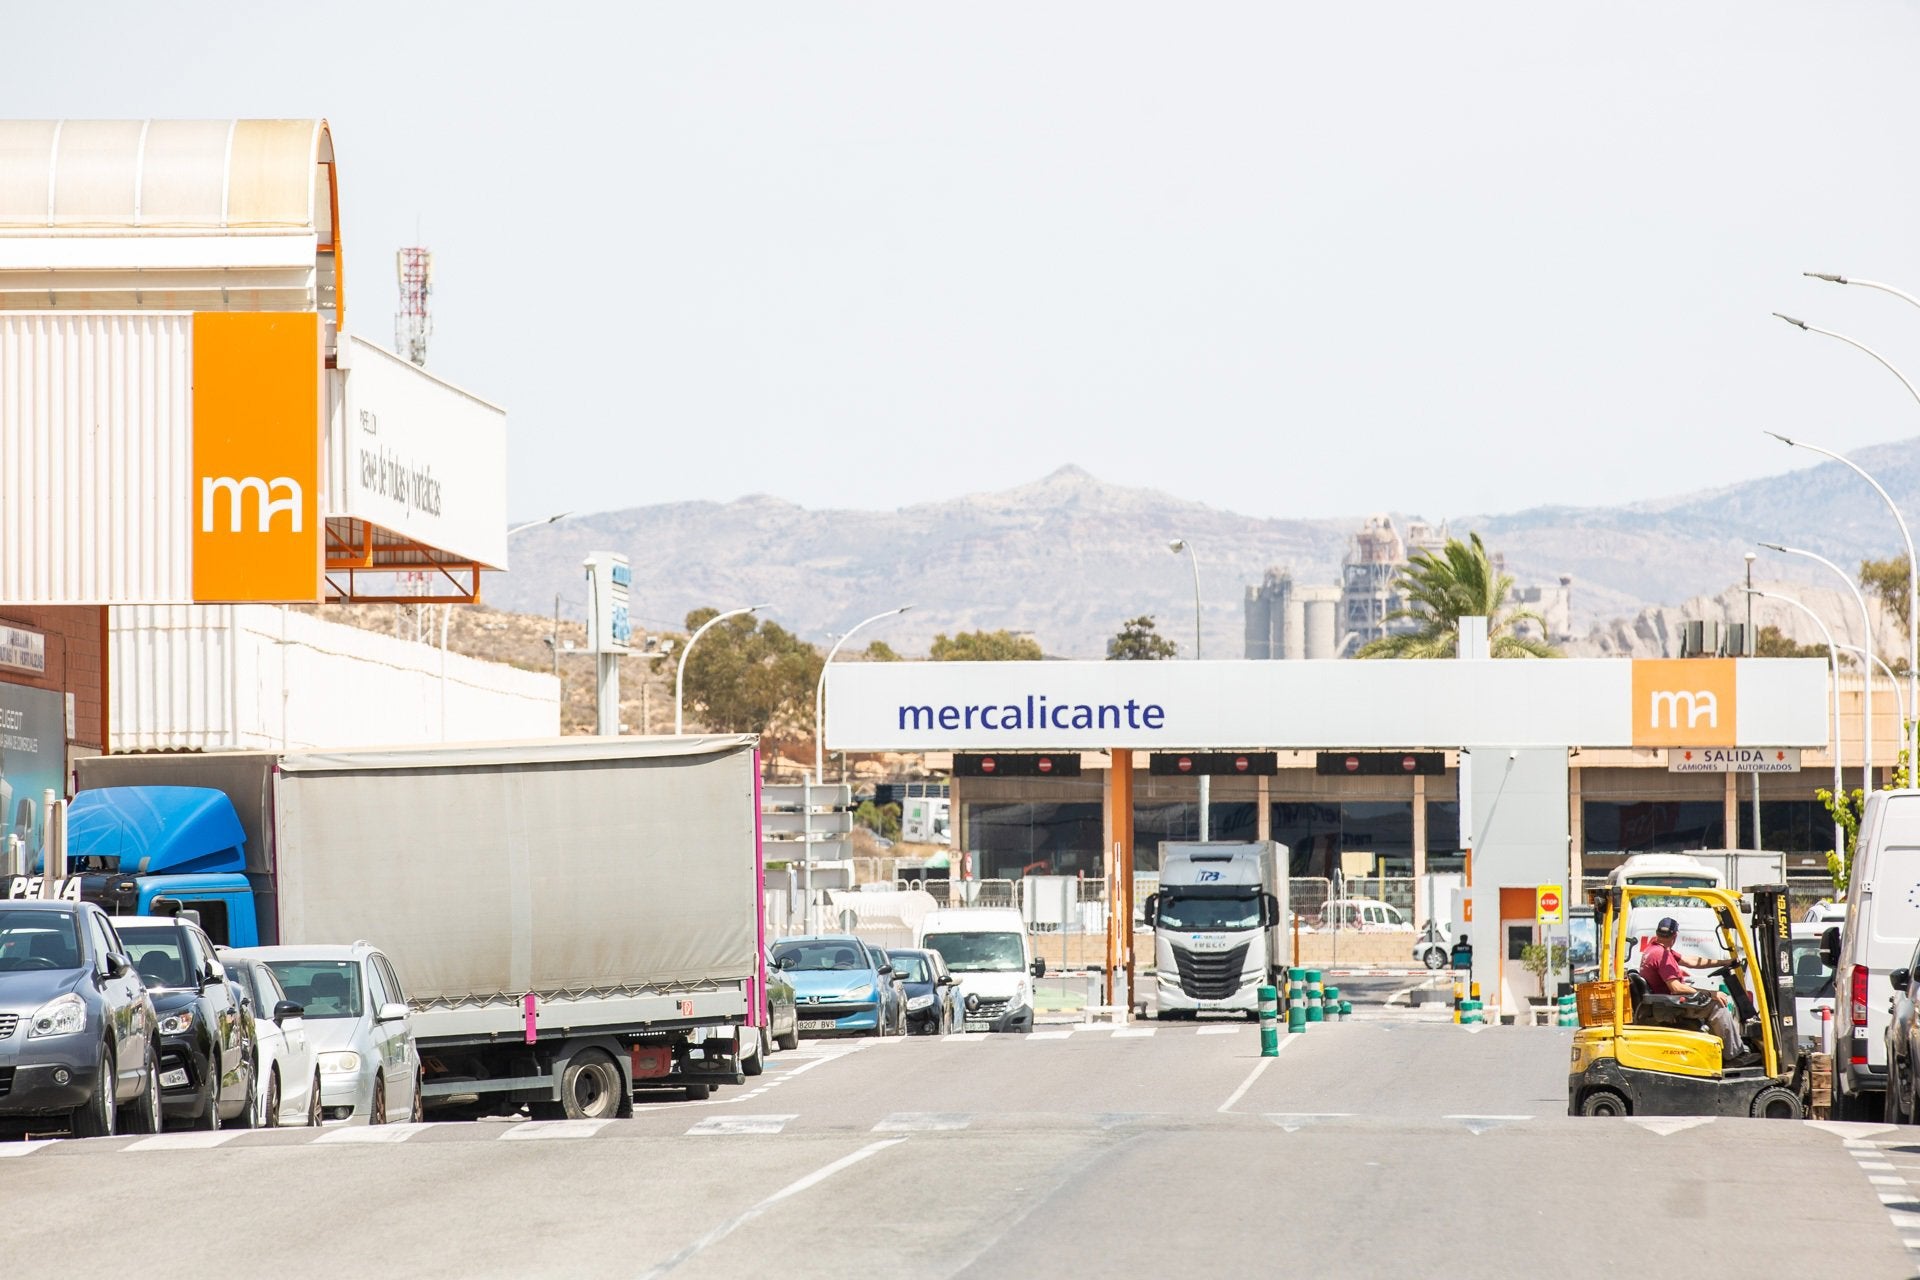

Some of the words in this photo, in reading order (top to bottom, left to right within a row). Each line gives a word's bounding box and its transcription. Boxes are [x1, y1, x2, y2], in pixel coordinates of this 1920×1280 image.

[360, 448, 376, 493] nave
[379, 443, 386, 497] de
[388, 447, 405, 504] frutas
[411, 456, 441, 518] hortalizas
[202, 476, 302, 533] ma
[899, 695, 1165, 730] mercalicante
[1651, 690, 1717, 728] ma
[1704, 750, 1764, 762] SALIDA
[1541, 898, 1558, 906] STOP
[1777, 894, 1788, 939] HYSTER
[800, 1021, 816, 1029] 8207
[821, 1021, 835, 1029] BVS
